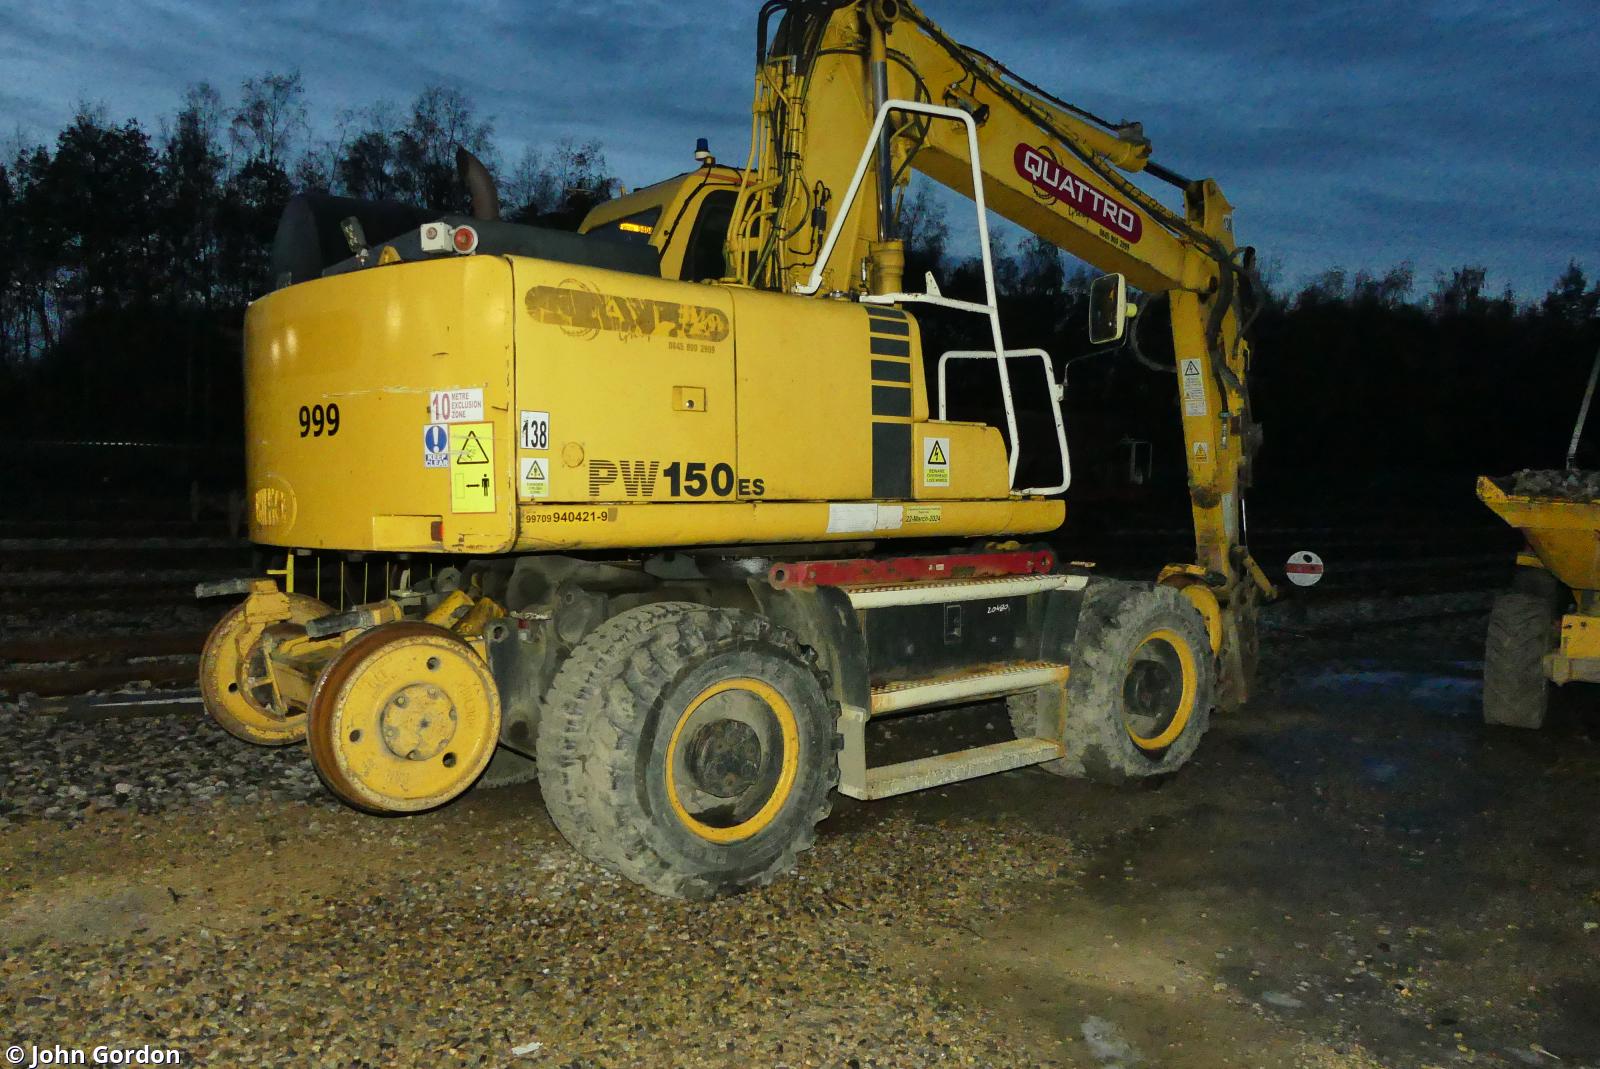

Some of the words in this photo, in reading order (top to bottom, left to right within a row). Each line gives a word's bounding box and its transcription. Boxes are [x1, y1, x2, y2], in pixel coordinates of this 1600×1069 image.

[1024, 150, 1135, 233] QUATTRO
[433, 393, 450, 420] 10
[451, 392, 469, 400] METRE
[451, 401, 482, 409] EXCLUSION
[299, 403, 340, 438] 999
[451, 410, 466, 419] ZONE
[522, 419, 547, 449] 138
